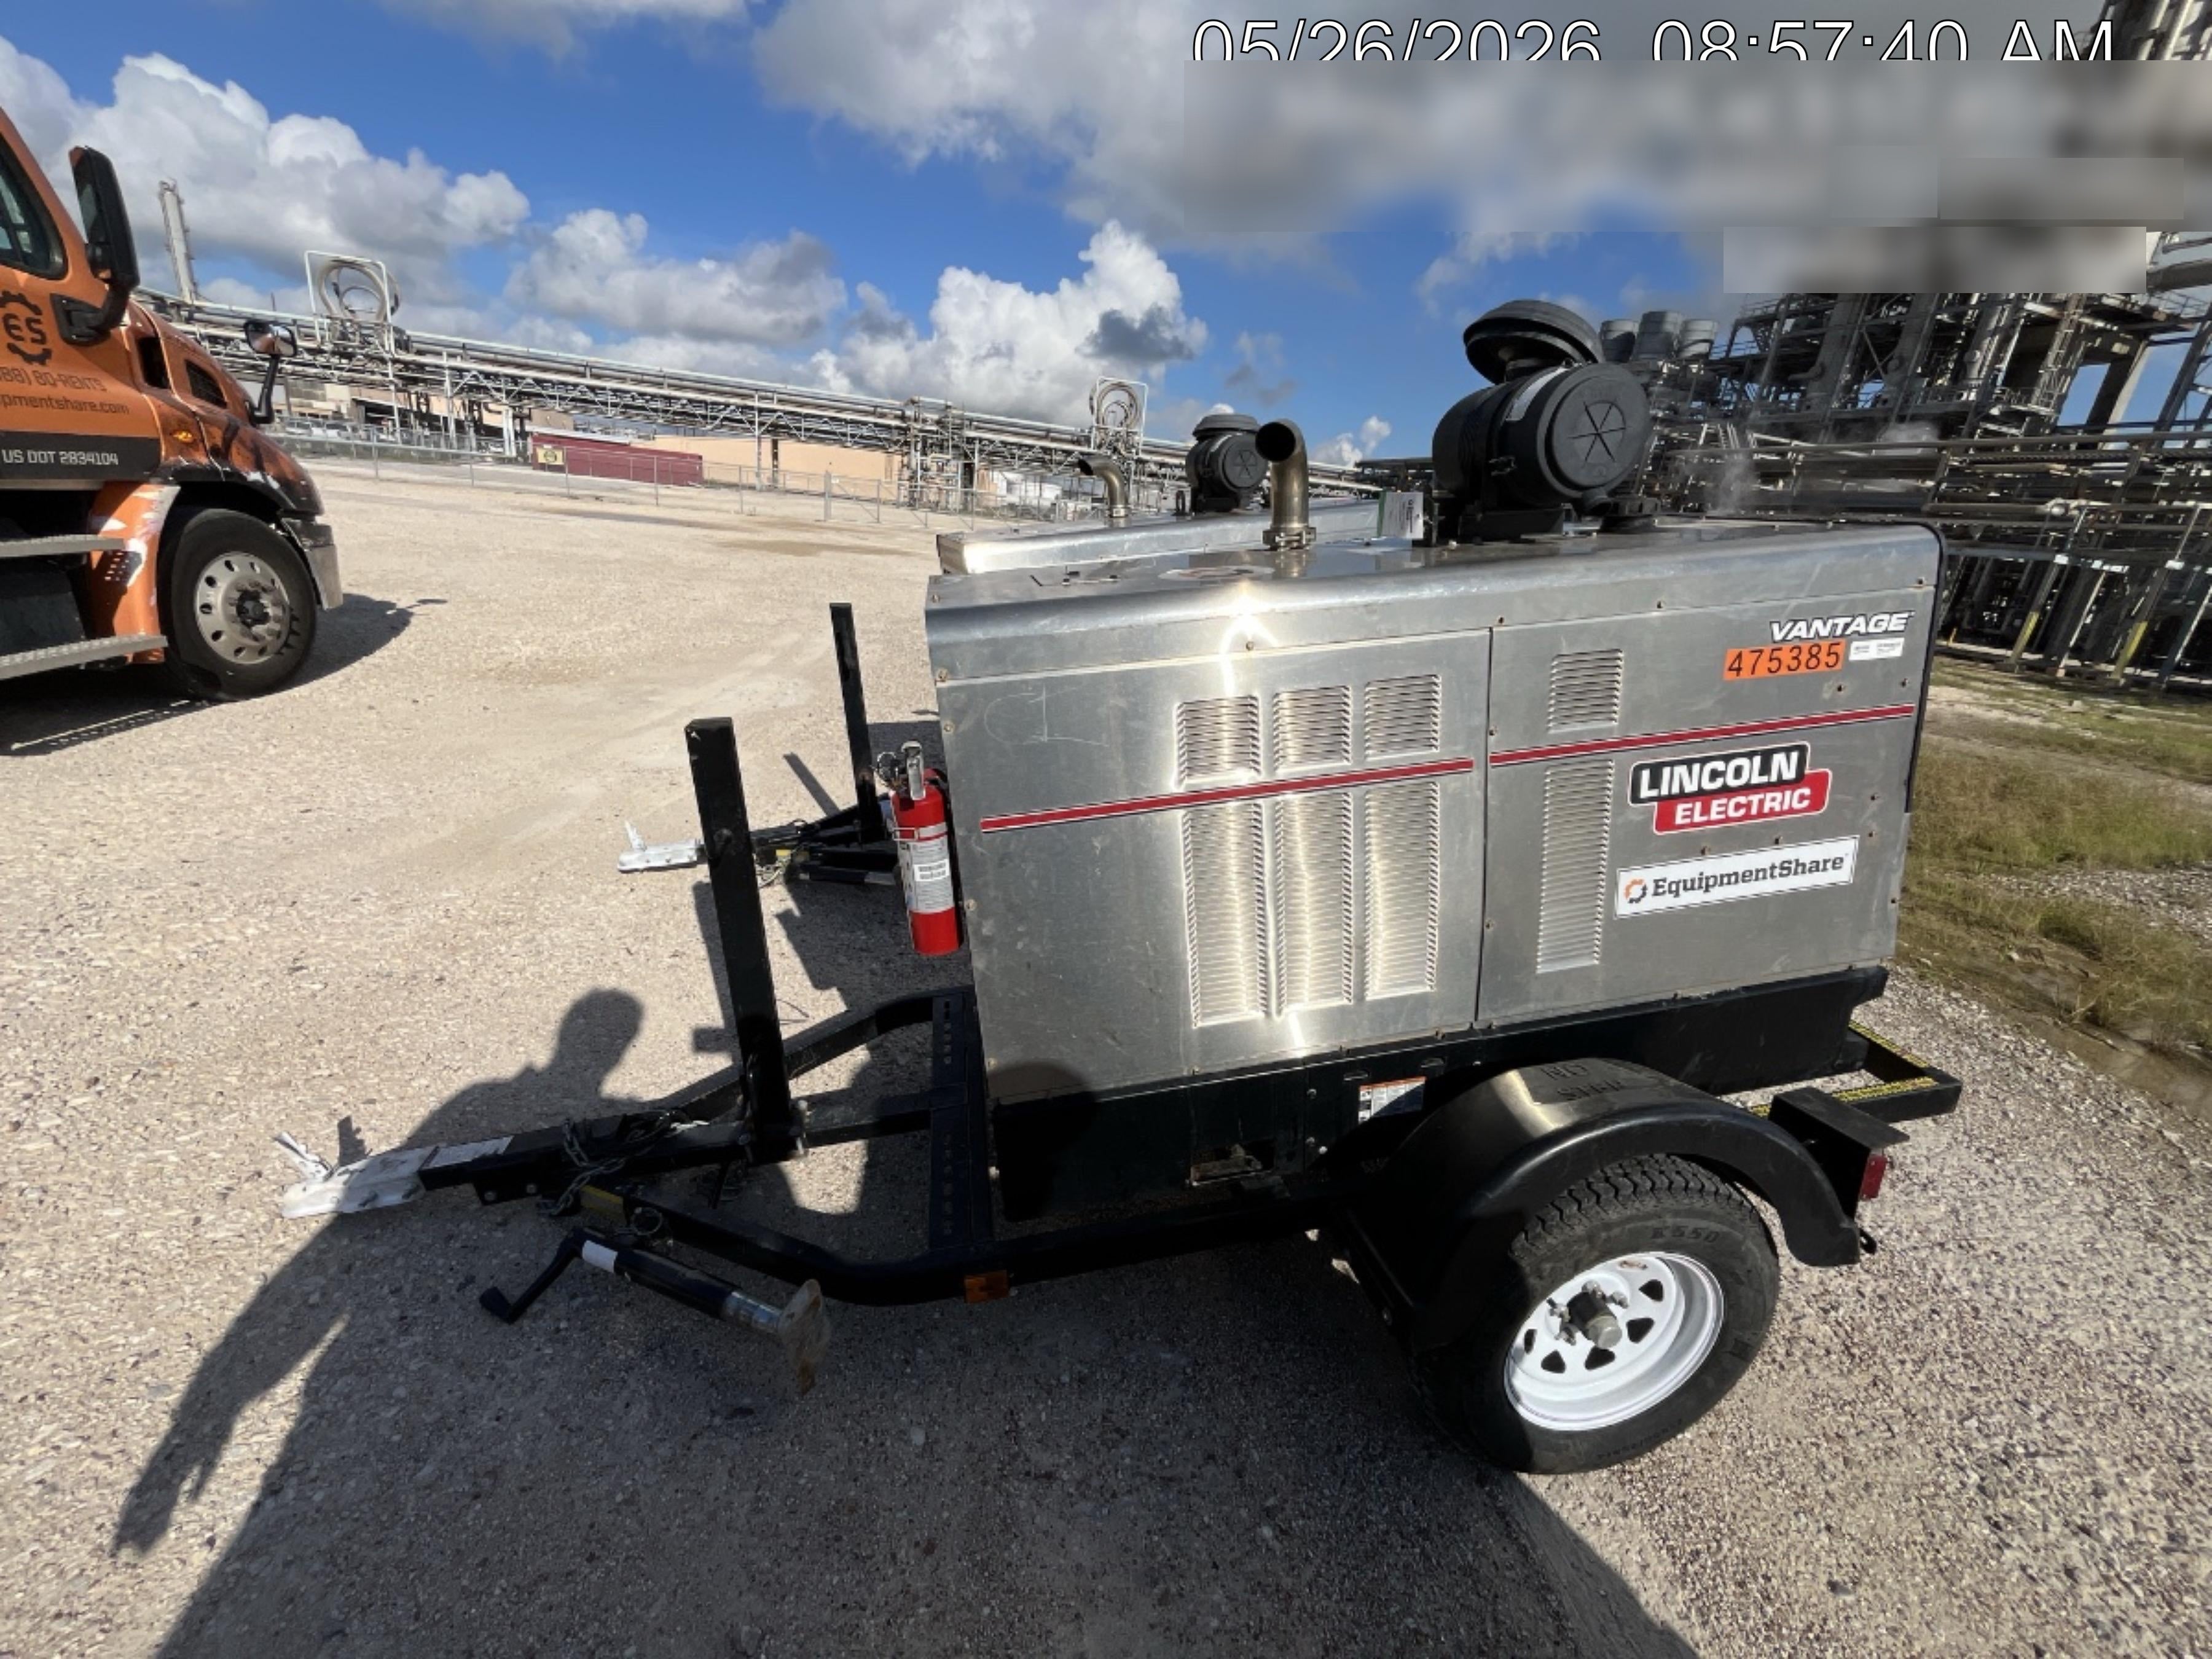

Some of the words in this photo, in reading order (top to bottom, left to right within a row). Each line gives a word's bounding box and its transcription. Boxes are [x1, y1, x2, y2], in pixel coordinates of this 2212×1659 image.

[2, 313, 47, 345] ES
[0, 366, 32, 386] 88)
[0, 393, 130, 414] pmentshare.com
[2, 449, 25, 464] US
[27, 450, 56, 464] DOT
[58, 450, 119, 466] 2834104
[1771, 614, 1909, 642] VANTAGE
[1727, 642, 1841, 677] 475385
[1639, 751, 1798, 799] LINCOLN
[1674, 788, 1811, 825] ELECTRIC
[1652, 856, 1844, 899] EquipmentShare
